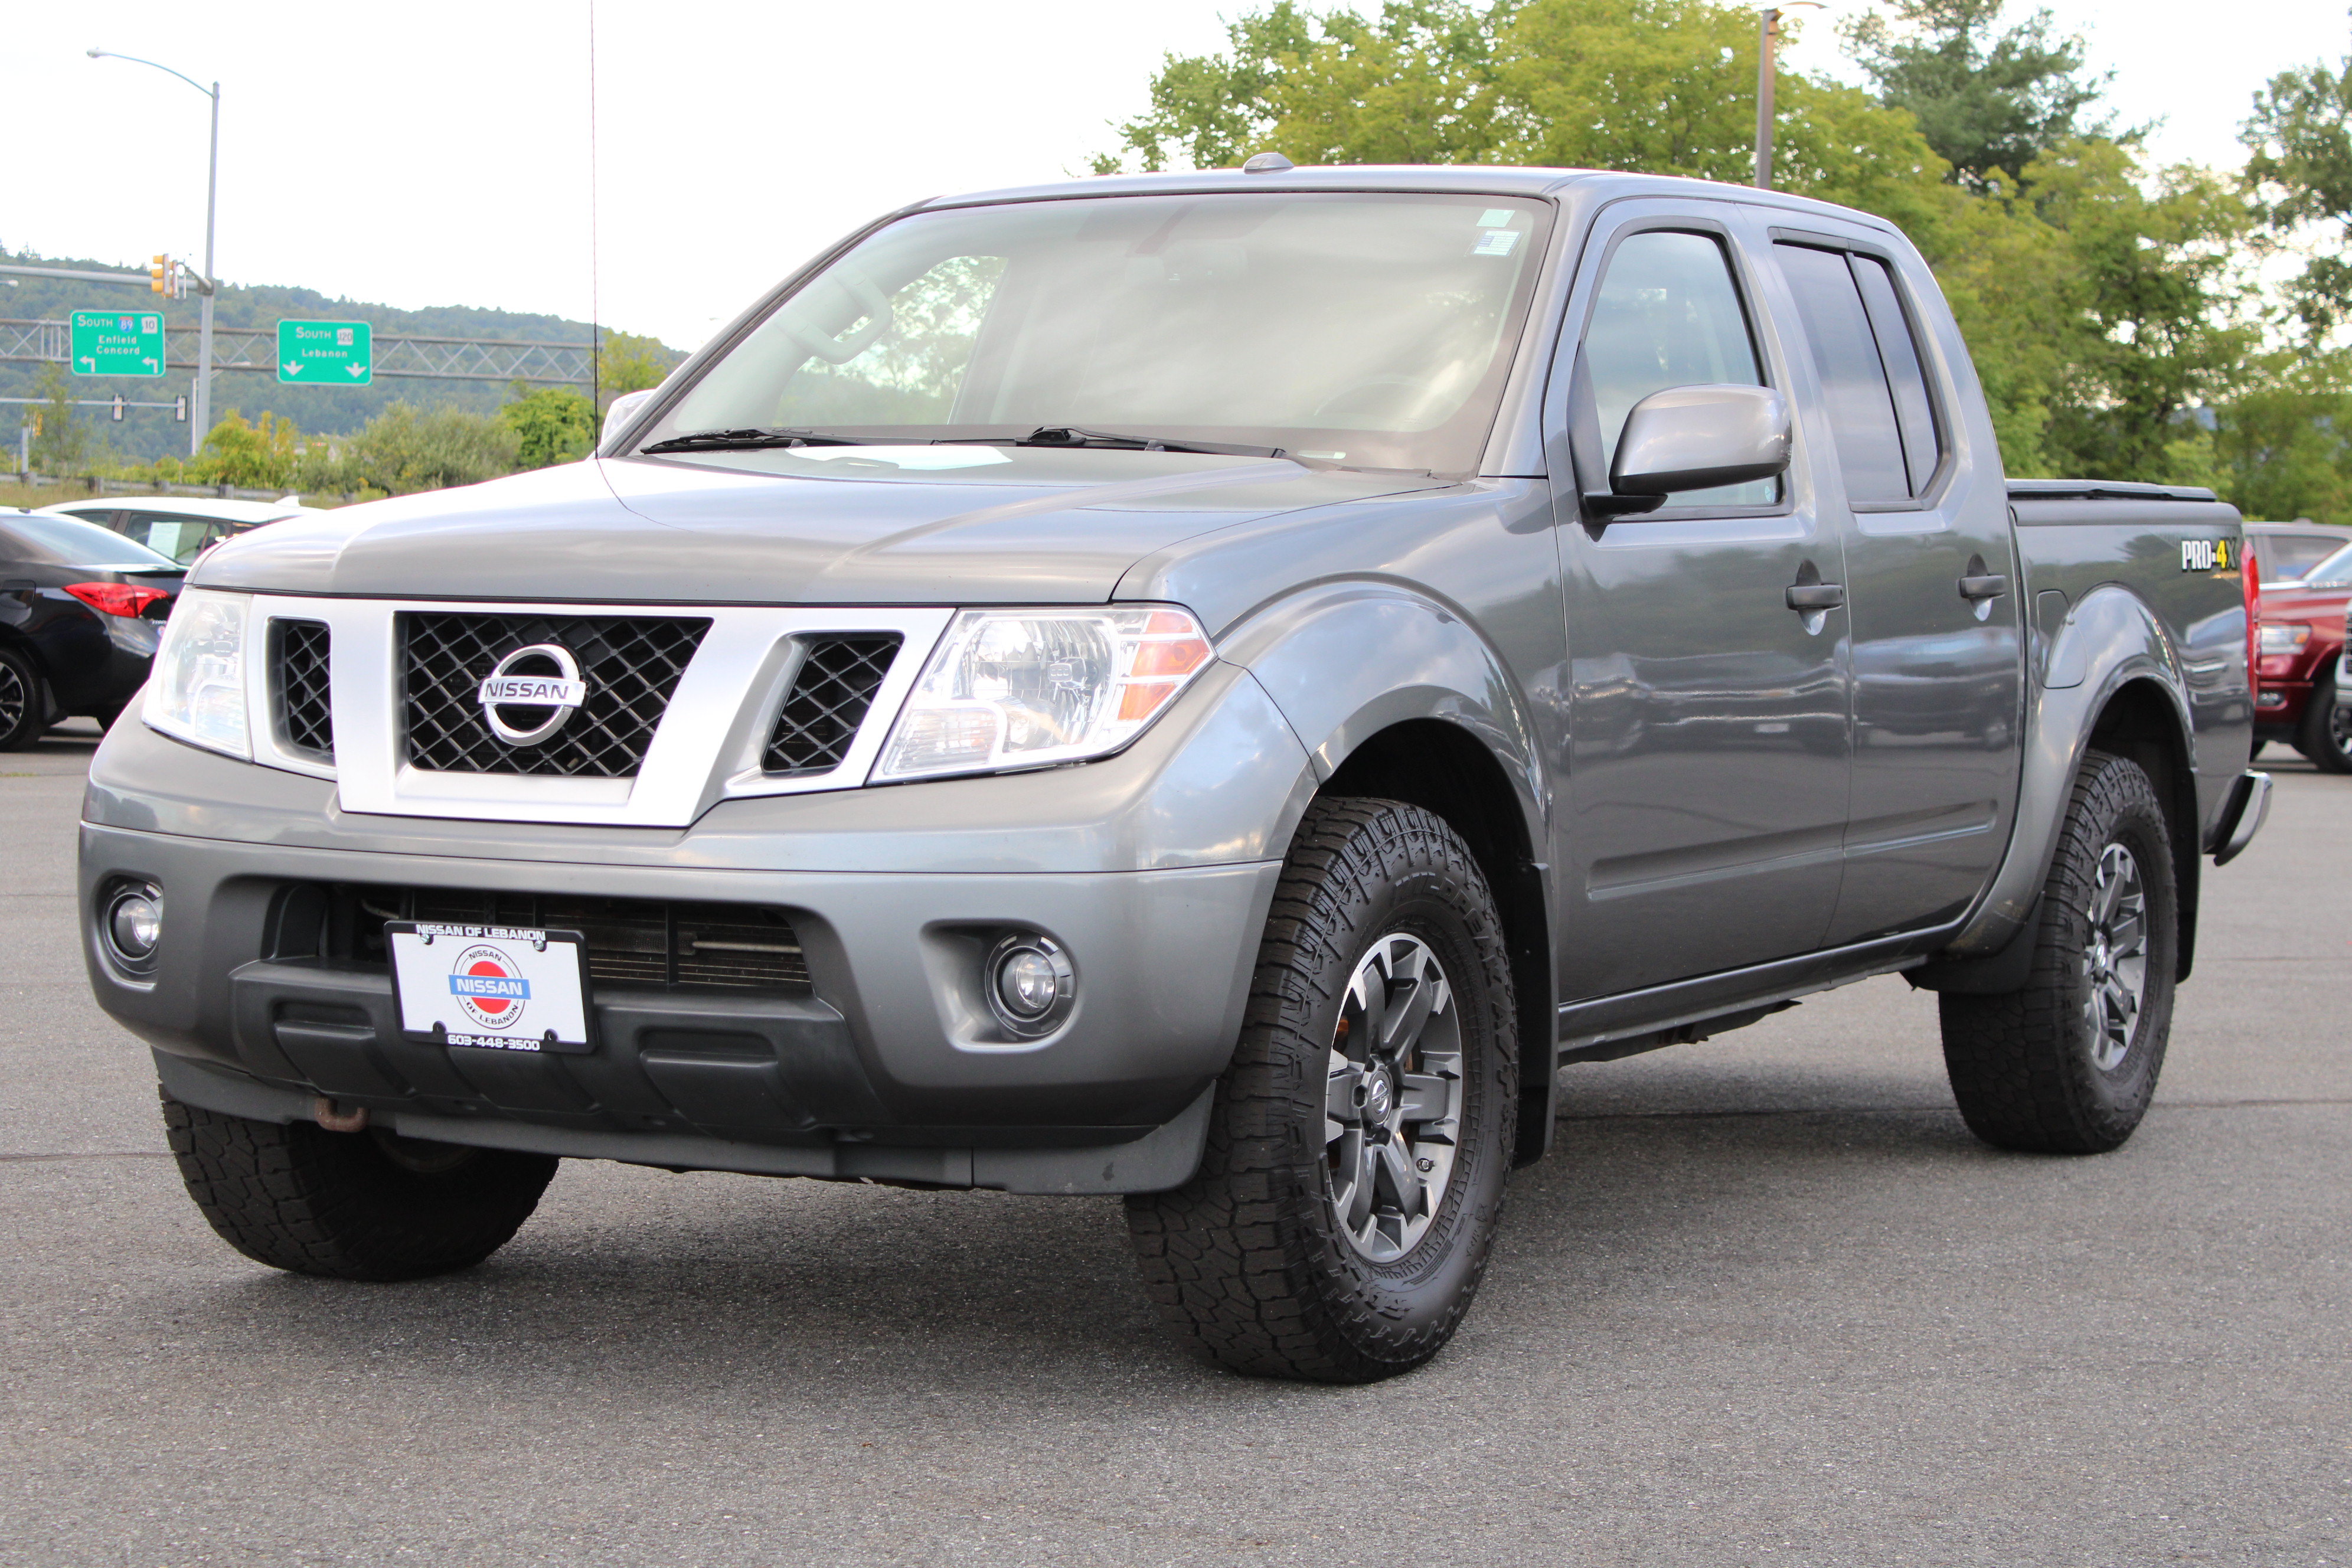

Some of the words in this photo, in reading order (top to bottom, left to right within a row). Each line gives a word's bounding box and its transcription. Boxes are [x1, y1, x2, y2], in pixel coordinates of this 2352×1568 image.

[78, 315, 113, 327] SOUTH
[120, 320, 133, 330] 89
[145, 320, 155, 329] 10
[99, 335, 137, 344] Enfield
[296, 326, 331, 339] SOUTH
[339, 332, 352, 341] 120
[96, 345, 140, 355] Concord
[302, 348, 348, 358] Lebanon
[2181, 538, 2237, 570] PRO-4X
[485, 682, 569, 700] NISSAN
[416, 924, 463, 937] NISSAN
[465, 926, 482, 937] OF
[484, 927, 546, 942] LEBANON
[469, 949, 502, 962] NISSAN
[456, 978, 523, 995] NISSAN
[466, 1001, 478, 1014] OF
[479, 1004, 518, 1025] LEBANON
[447, 1034, 540, 1051] 603-448-3500
